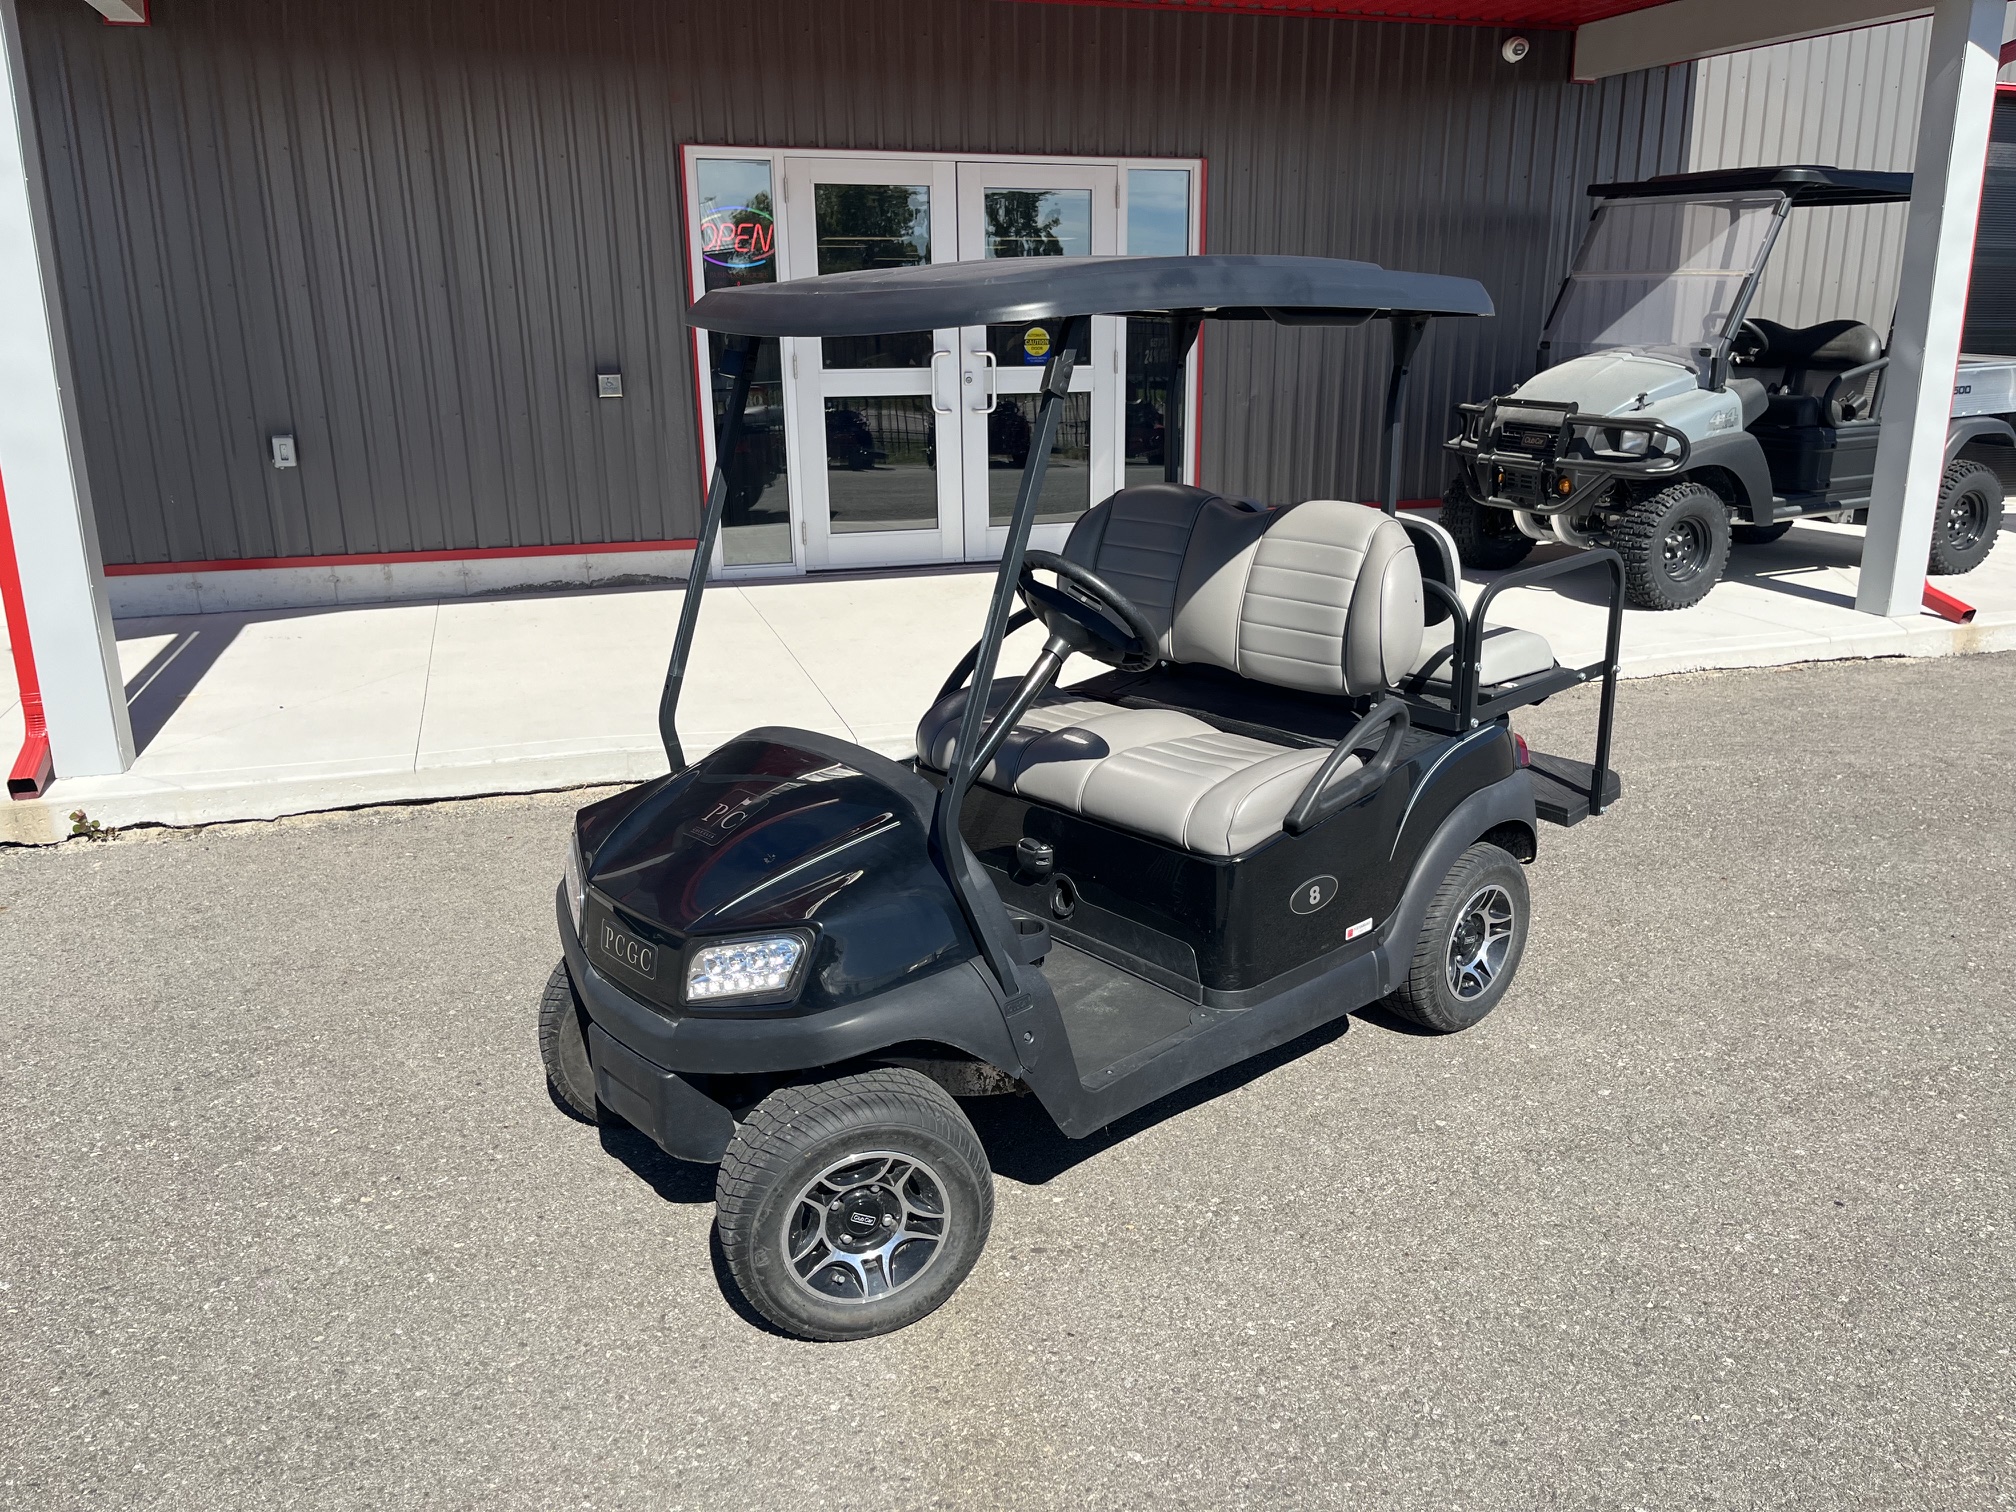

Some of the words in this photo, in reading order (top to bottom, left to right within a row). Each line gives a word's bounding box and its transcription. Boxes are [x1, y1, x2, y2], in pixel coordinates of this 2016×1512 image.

[701, 222, 774, 253] OPEN
[1309, 885, 1321, 905] 8
[605, 926, 652, 972] PCGC
